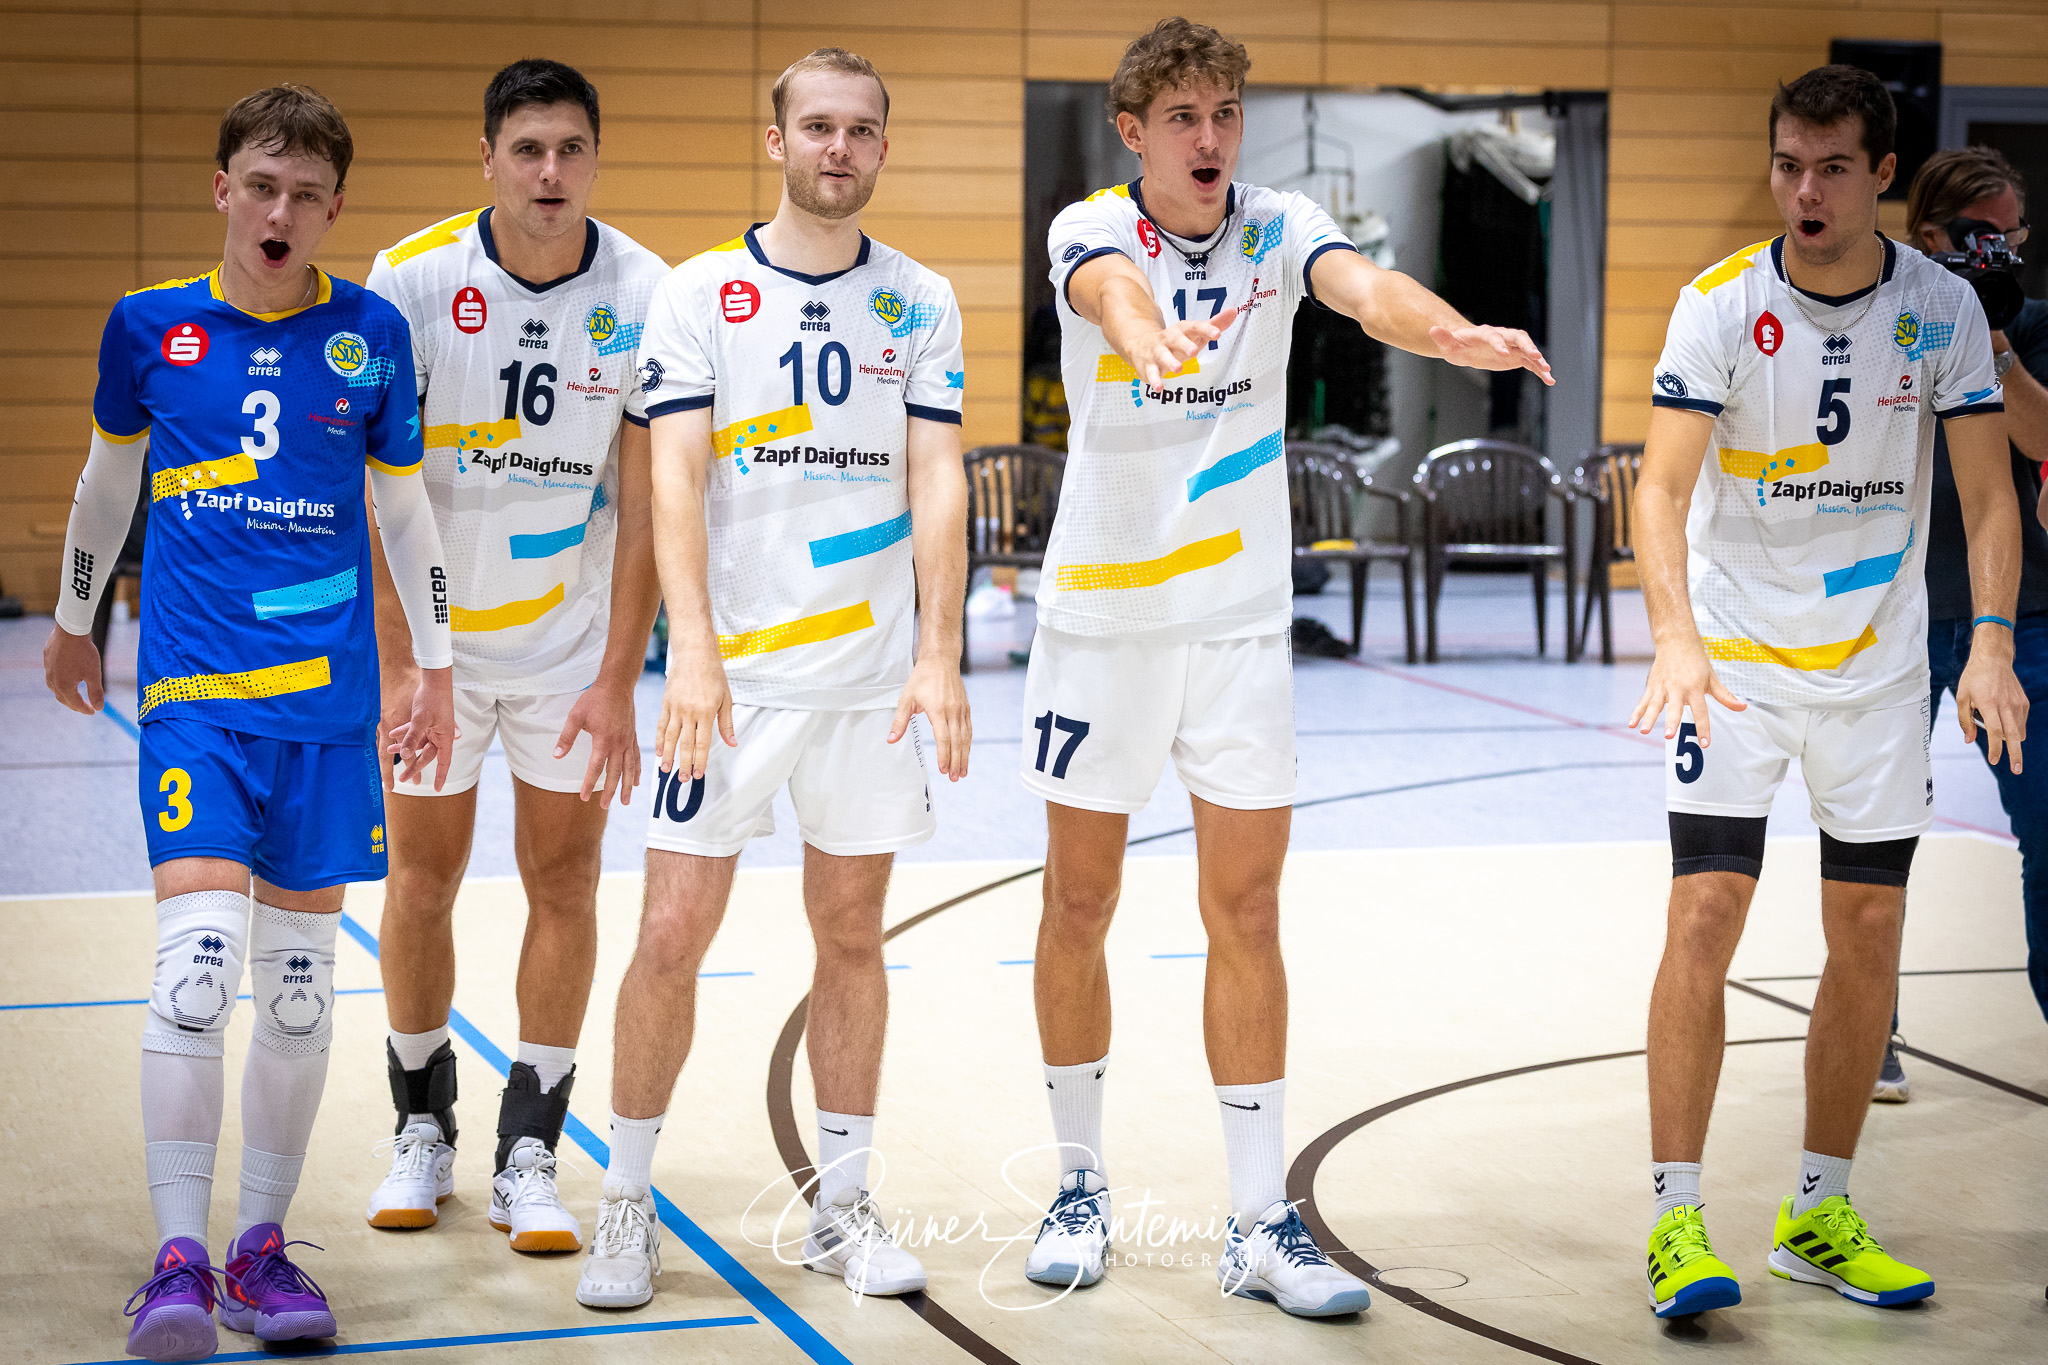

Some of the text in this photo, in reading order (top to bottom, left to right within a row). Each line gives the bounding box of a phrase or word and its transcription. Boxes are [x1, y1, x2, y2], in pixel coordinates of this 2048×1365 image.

[800, 320, 830, 332] errea
[1172, 286, 1227, 350] 17
[518, 336, 548, 350] errea
[248, 366, 281, 376] errea
[780, 340, 852, 406] 10
[859, 364, 904, 378] Heinzelm
[1822, 354, 1851, 366] errea
[499, 360, 558, 426] 16
[876, 376, 900, 385] Medien
[1186, 378, 1252, 406] Daiguss
[1816, 378, 1852, 446] 5
[1877, 392, 1920, 407] Heizelm
[240, 390, 280, 460] 3
[472, 449, 593, 477] Zapf Daigfuss
[754, 446, 890, 468] Zapf Daigfuss
[195, 490, 335, 518] Zapf Daigfuss
[1771, 480, 1904, 503] Zapf Daigfuss
[430, 566, 446, 604] cep
[1034, 710, 1090, 780] 17
[1675, 722, 1704, 784] 5
[158, 767, 194, 832] 3
[652, 764, 706, 823] 10
[193, 954, 224, 968] errea
[282, 974, 312, 984] errea
